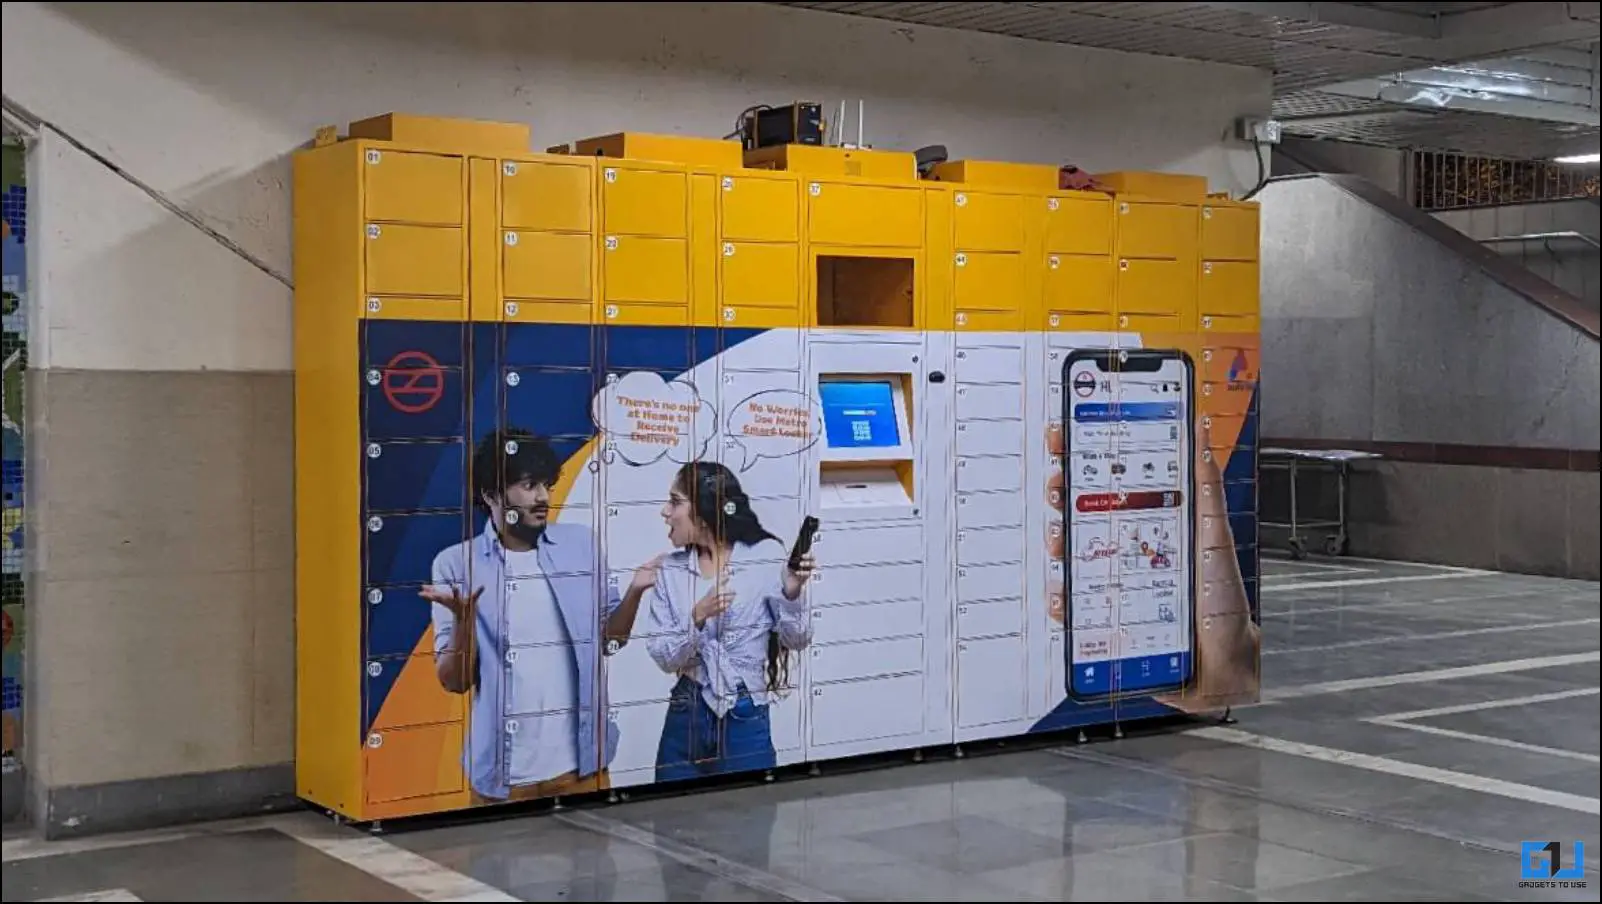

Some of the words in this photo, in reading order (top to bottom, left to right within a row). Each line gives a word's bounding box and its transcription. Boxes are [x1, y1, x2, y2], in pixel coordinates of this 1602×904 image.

[662, 402, 677, 411] no
[749, 402, 763, 413] No
[627, 410, 641, 418] at
[642, 411, 676, 422] Home
[776, 416, 808, 428] Metro
[637, 420, 680, 433] Receive
[631, 432, 680, 446] Delivery
